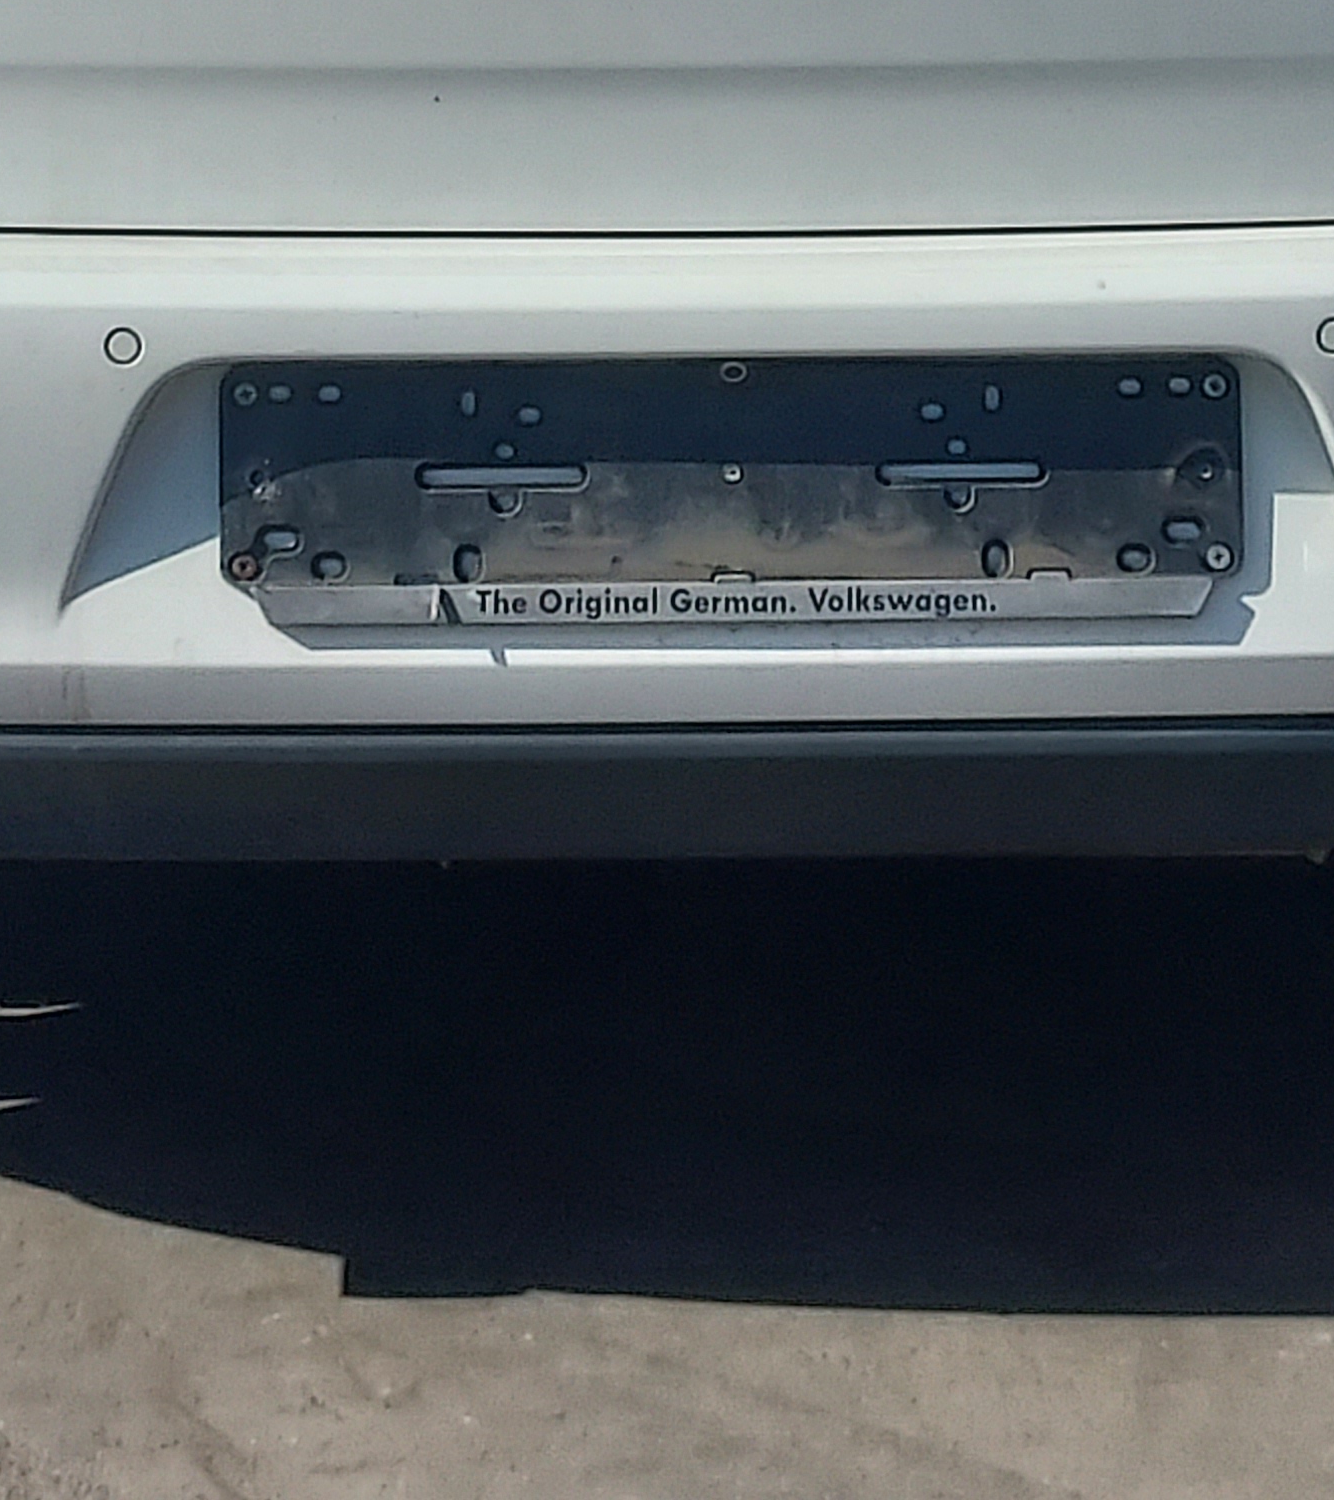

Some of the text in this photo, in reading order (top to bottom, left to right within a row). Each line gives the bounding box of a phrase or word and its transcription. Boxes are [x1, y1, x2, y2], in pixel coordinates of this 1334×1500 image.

[475, 586, 998, 620] The Original German. Volkswagen.
